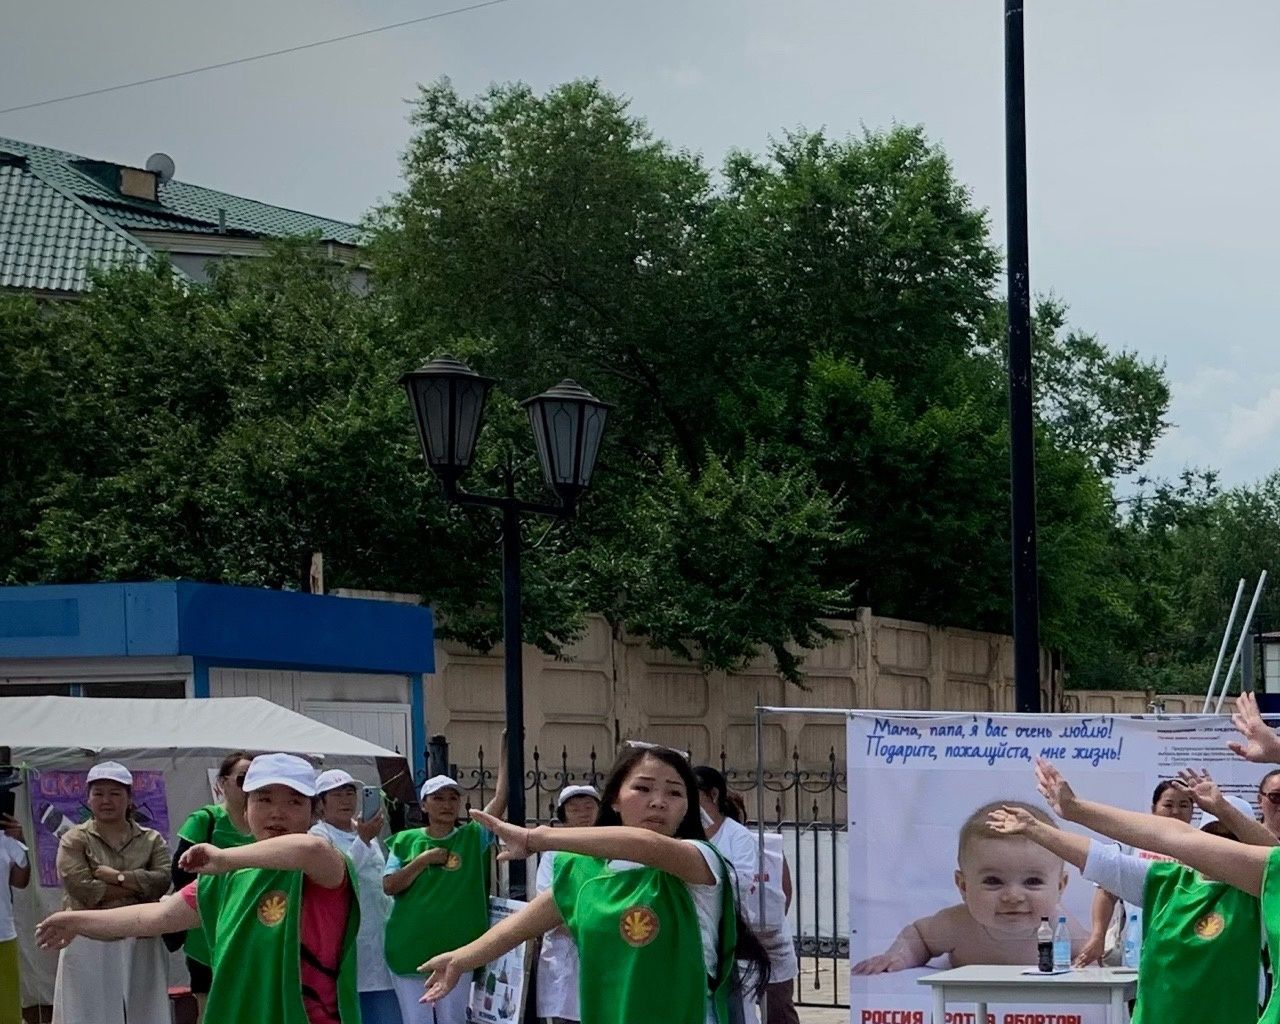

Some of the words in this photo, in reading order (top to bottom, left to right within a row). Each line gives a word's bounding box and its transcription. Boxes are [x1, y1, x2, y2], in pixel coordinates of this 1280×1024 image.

[873, 718, 922, 739] Мама,
[930, 726, 966, 740] папа,
[969, 725, 978, 737] я
[985, 718, 1008, 738] вас
[1016, 727, 1053, 738] очень
[1058, 718, 1114, 739] люблю!
[866, 735, 938, 764] Подарите,
[944, 741, 1032, 766] пожалуйста,
[1040, 747, 1066, 759] мне
[1071, 736, 1124, 768] жизнь!
